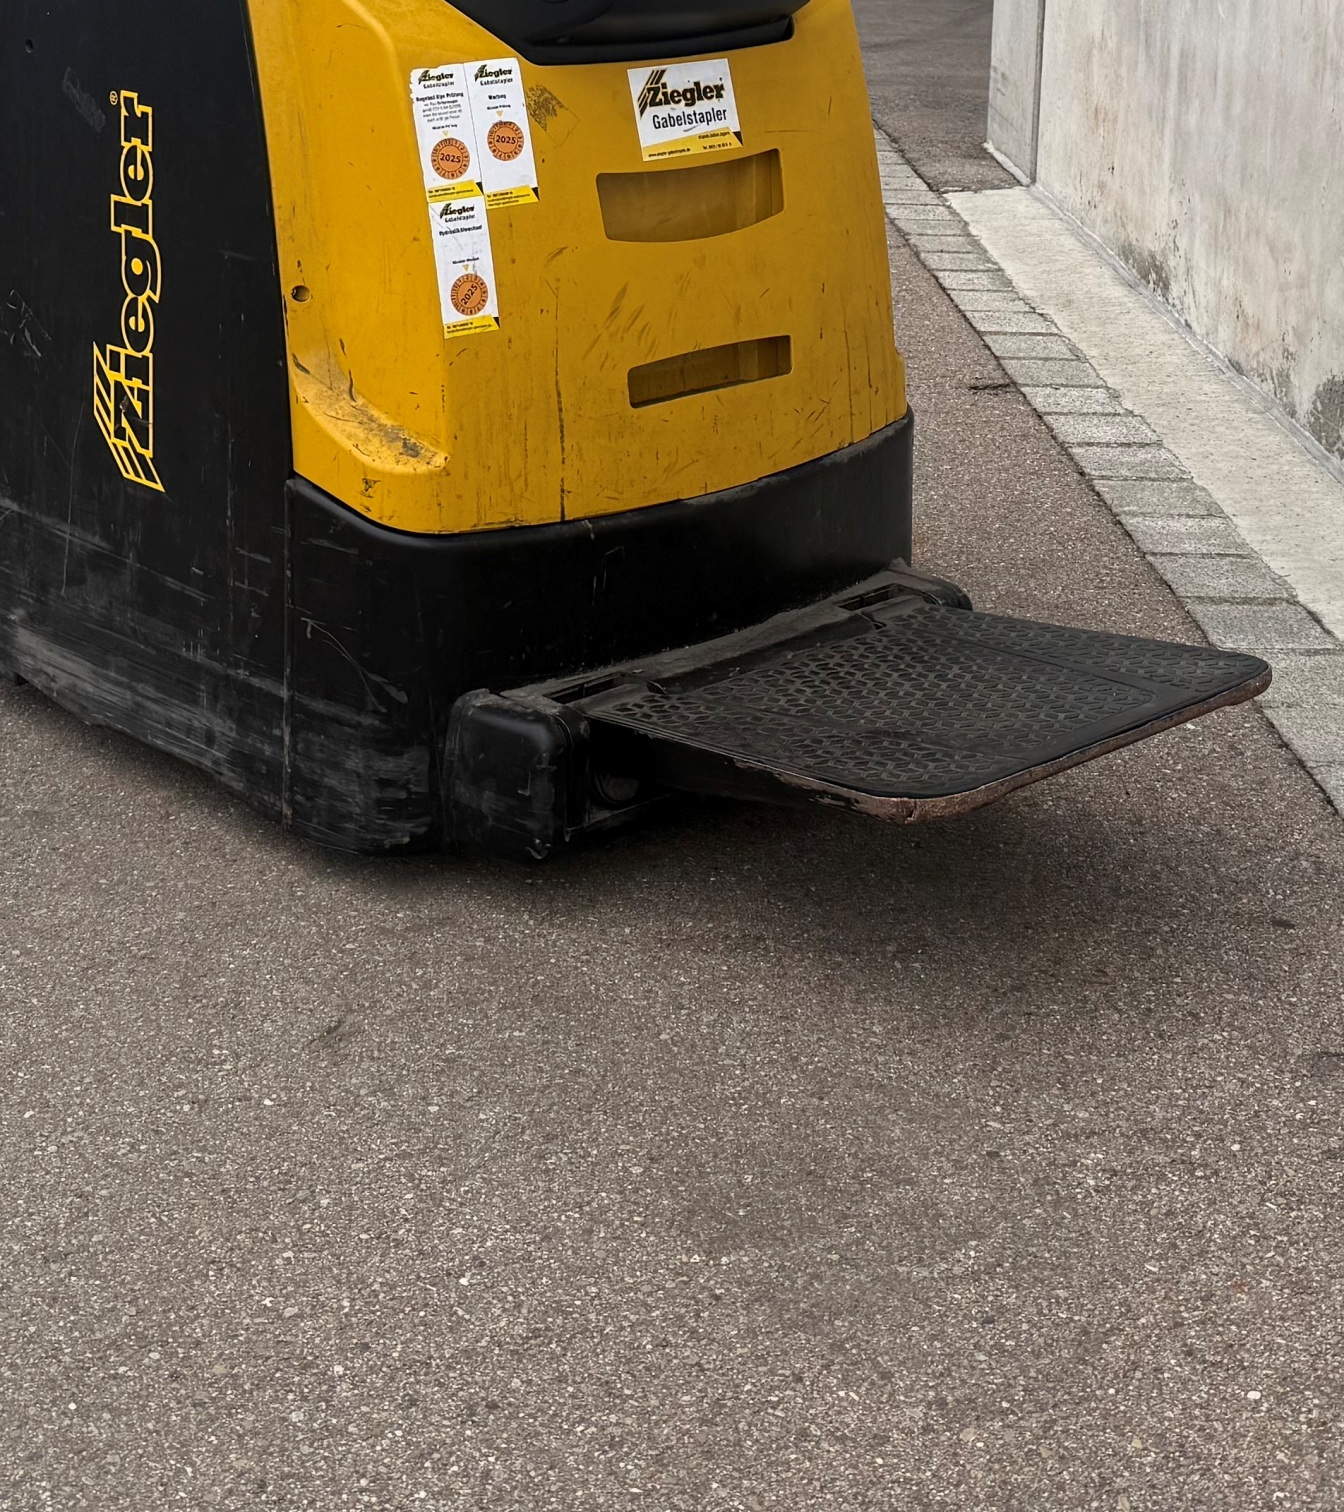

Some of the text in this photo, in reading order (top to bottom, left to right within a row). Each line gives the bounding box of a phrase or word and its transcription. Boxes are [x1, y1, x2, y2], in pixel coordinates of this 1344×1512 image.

[642, 74, 726, 110] Ziegler
[652, 107, 727, 130] Gabelstapler
[496, 134, 516, 145] 2025
[440, 153, 461, 164] 2025
[104, 88, 164, 473] Ziegler
[460, 283, 479, 306] 2025
